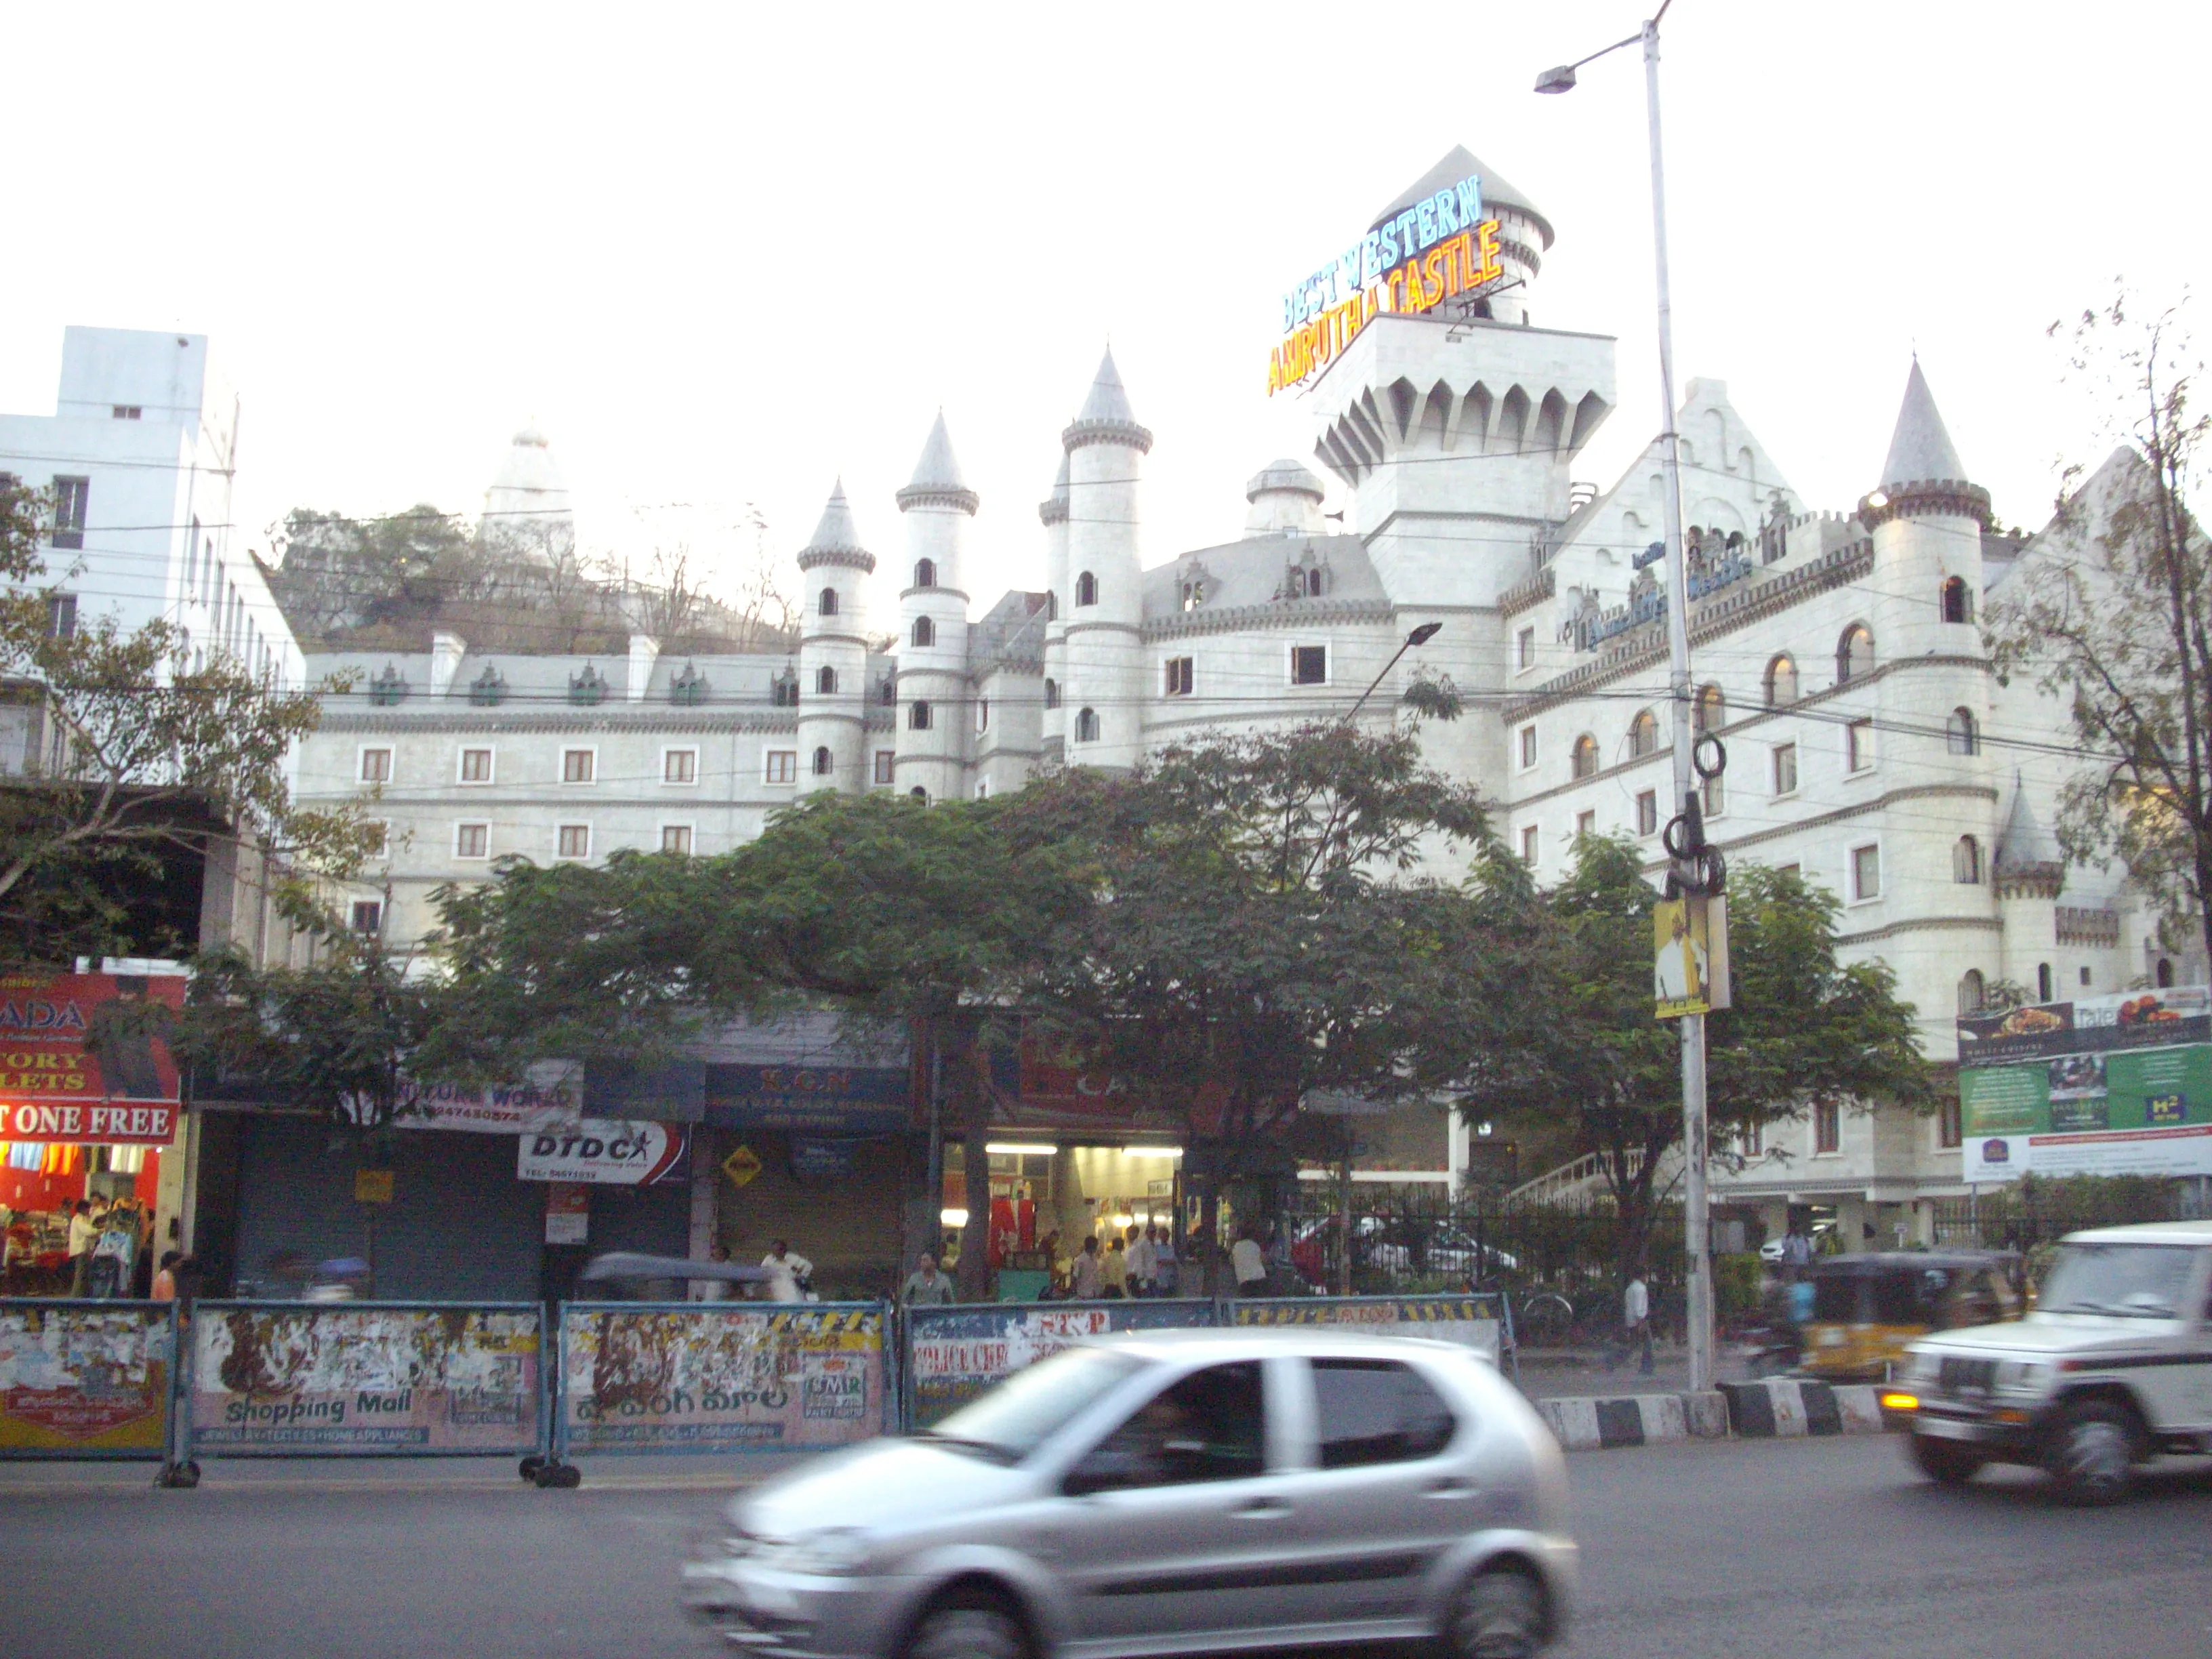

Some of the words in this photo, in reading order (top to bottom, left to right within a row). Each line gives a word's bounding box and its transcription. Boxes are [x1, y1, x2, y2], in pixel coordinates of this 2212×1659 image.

[1282, 260, 1339, 333] BEST
[1340, 173, 1483, 288] WESTERN
[1266, 282, 1378, 397] AMRUTHA
[1386, 219, 1504, 314] CASTLE
[0, 1052, 87, 1069] ORY
[15, 1105, 81, 1134] ONE
[88, 1107, 169, 1136] FREE
[531, 1135, 629, 1159] DTDC
[226, 1393, 346, 1423] Shopping
[356, 1388, 413, 1414] Mall
